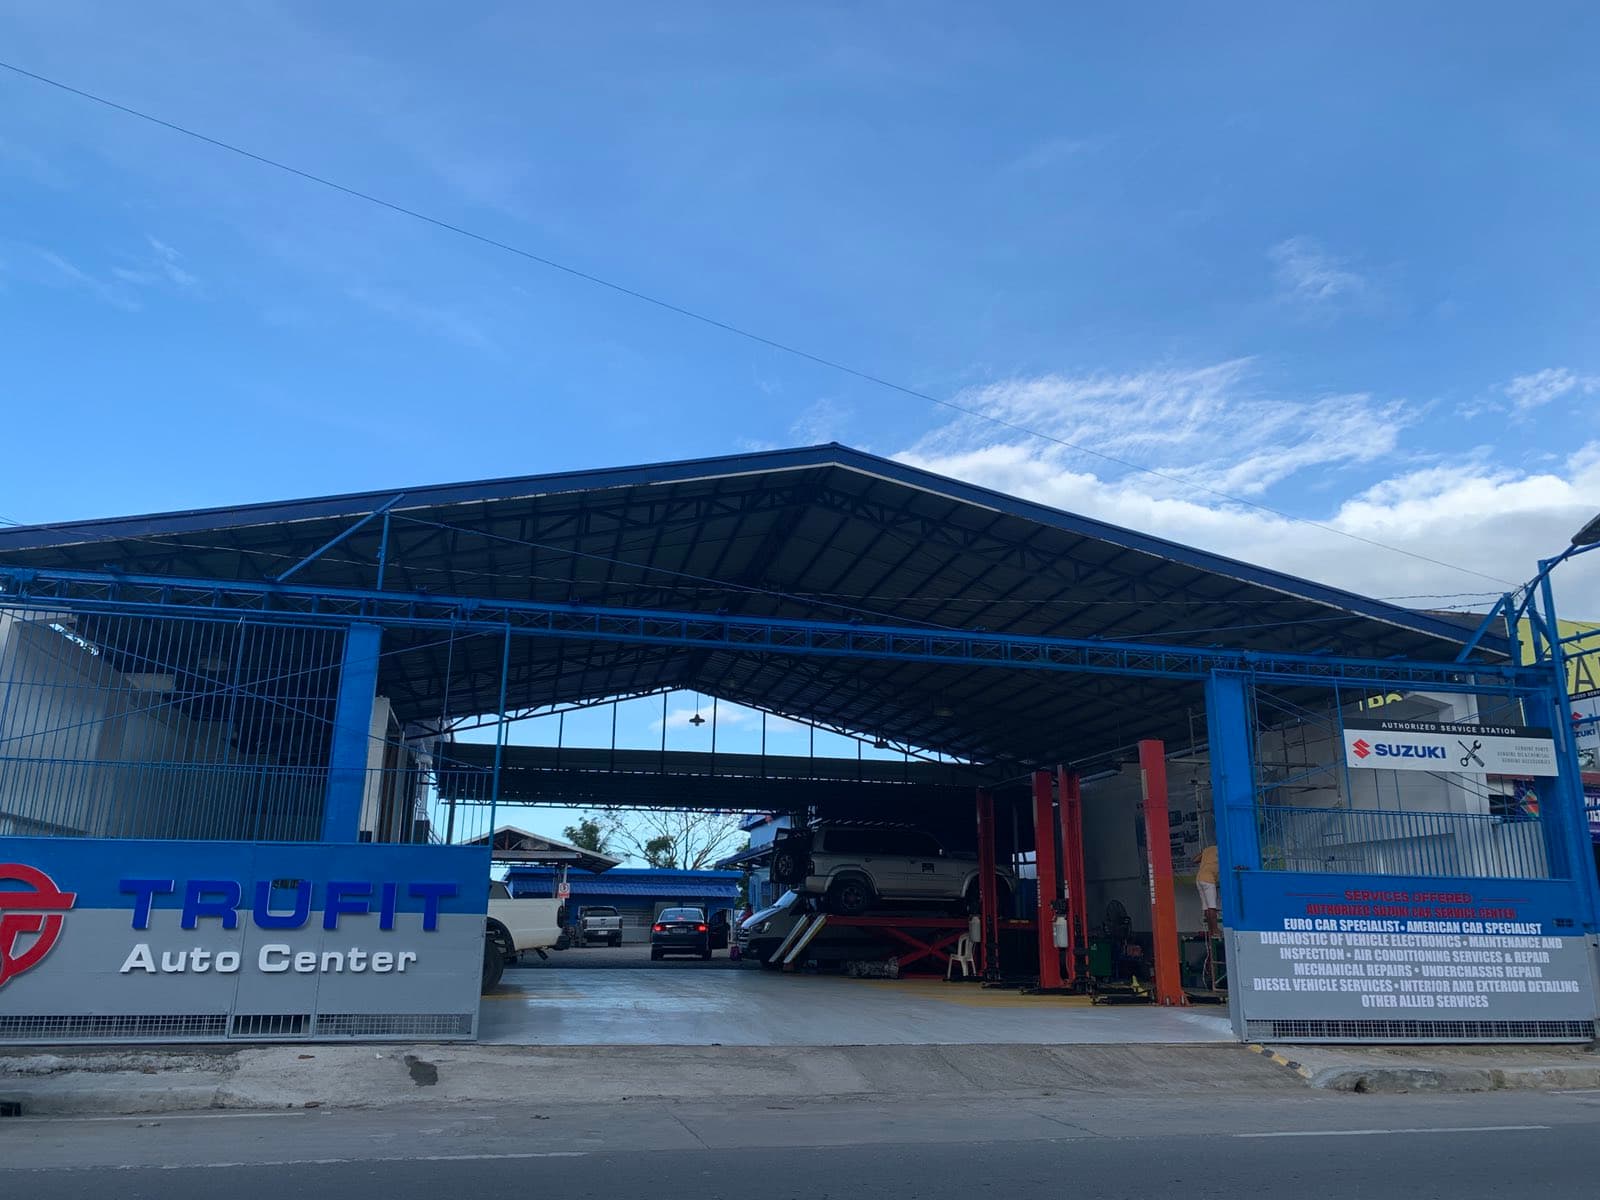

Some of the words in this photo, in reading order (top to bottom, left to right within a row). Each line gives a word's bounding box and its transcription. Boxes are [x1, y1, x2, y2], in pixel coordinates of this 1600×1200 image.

[1381, 722, 1436, 731] AUTHORIZED
[1440, 725, 1477, 733] SERVICE
[1480, 727, 1516, 735] STATION
[1374, 743, 1446, 759] SUZUKI
[1345, 890, 1409, 902] SERVICES
[1413, 892, 1472, 904] OFFERED
[119, 879, 457, 932] TRUFIT
[1307, 904, 1370, 916] AUTHORIZED
[1435, 907, 1475, 918] SERVICE
[1479, 908, 1516, 919] CENTER
[1284, 918, 1312, 931] EURO
[1314, 919, 1337, 931] CAR
[1339, 919, 1400, 932] SPECIALIST
[1407, 920, 1461, 934] AMERICAN
[1462, 922, 1483, 934] CAR
[1485, 922, 1542, 935] SPECIALIST
[1260, 931, 1328, 945] DIAGNOSTIC
[1329, 933, 1344, 945] OF
[1345, 934, 1390, 947] VEHICLE
[1391, 935, 1461, 948] ELECTRONICS
[1469, 936, 1541, 949] MAINTENANCE
[1541, 937, 1562, 949] AND
[120, 943, 240, 973] Auto
[257, 943, 418, 973] Center
[1280, 947, 1344, 960] INSPECTION
[1354, 949, 1373, 961] AIR
[1374, 949, 1451, 963] CONDITIONING
[1452, 951, 1503, 963] SERVICES
[1504, 952, 1513, 963] &
[1514, 952, 1550, 964] REPAIR
[1294, 963, 1365, 976] MECHANICAL
[1367, 964, 1412, 977] REPAIRS
[1422, 965, 1504, 978] UNDERCHASSIS
[1505, 966, 1542, 978] REPAIR
[1253, 978, 1291, 991] DIESEL
[1293, 978, 1338, 992] VEHICLE
[1339, 979, 1393, 992] SERVICES
[1400, 979, 1451, 993] INTERIOR
[1452, 980, 1474, 993] AND
[1476, 980, 1526, 993] EXTERIOR
[1527, 980, 1580, 993] DETAILING
[1361, 995, 1398, 1008] OTHER
[1399, 995, 1435, 1008] ALLIED
[1436, 995, 1489, 1008] SERVICES
